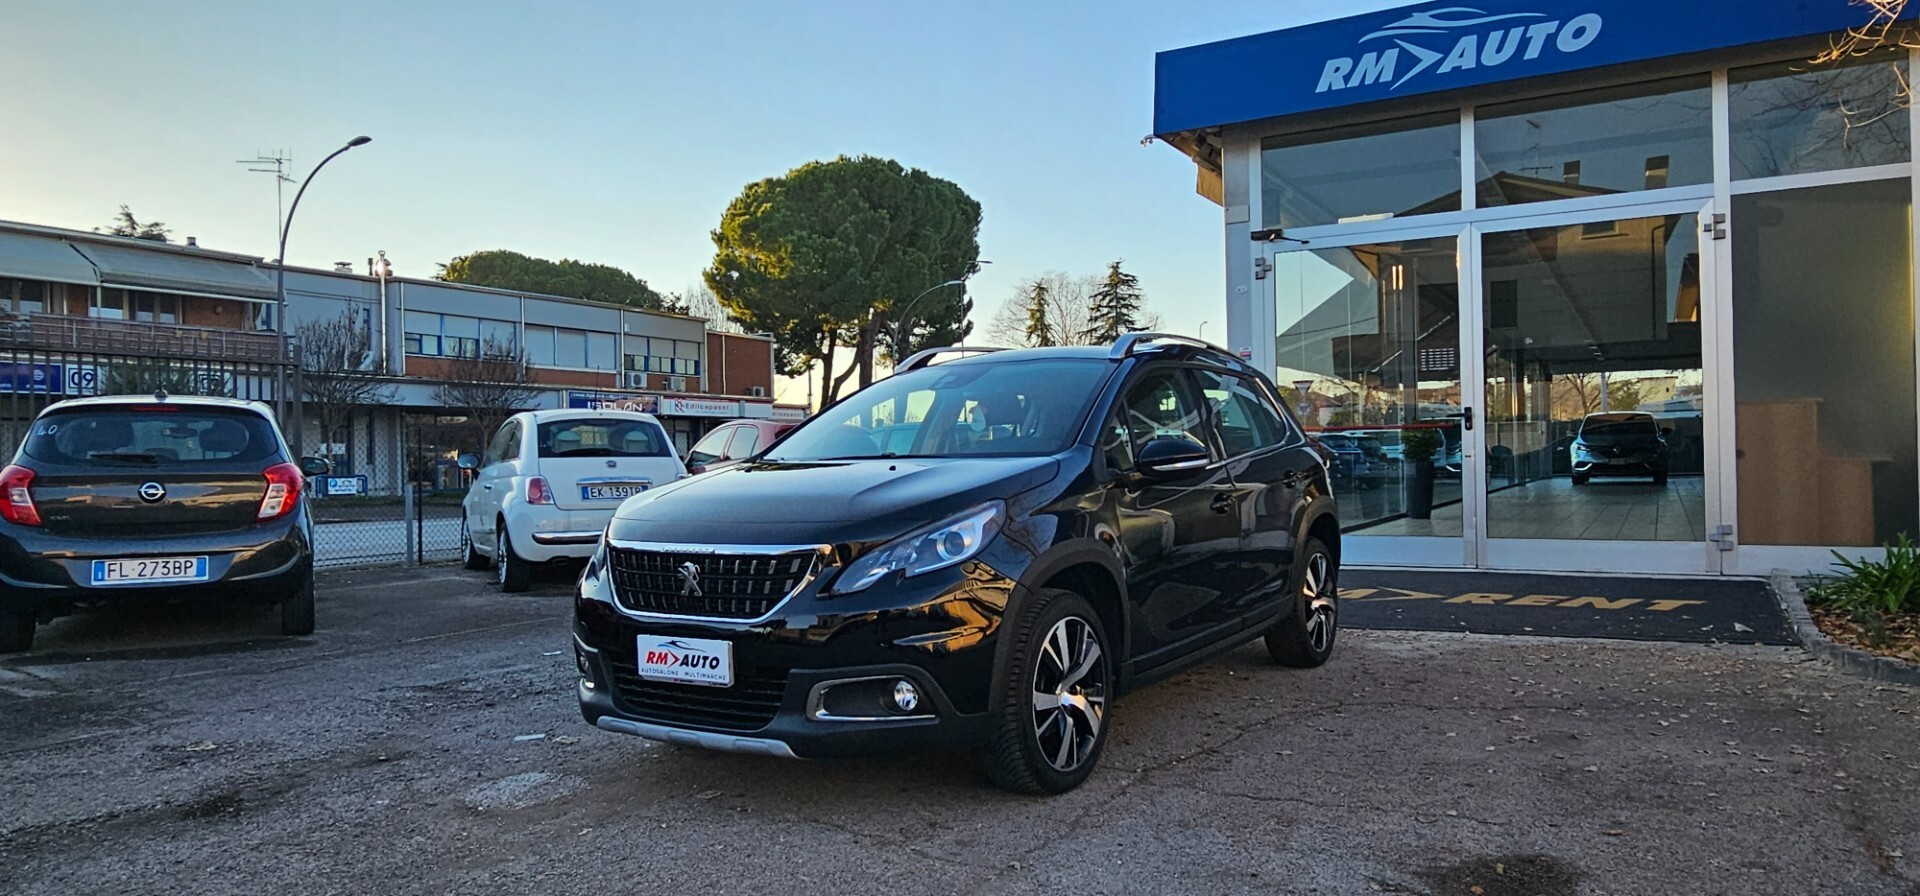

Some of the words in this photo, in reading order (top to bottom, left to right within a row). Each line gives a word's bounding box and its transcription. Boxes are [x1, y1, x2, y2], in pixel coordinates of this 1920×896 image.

[1315, 48, 1400, 93] RM
[1436, 12, 1603, 74] AUTO
[71, 372, 94, 386] 09
[590, 487, 604, 498] EK
[107, 562, 129, 579] FL
[137, 560, 194, 578] 273BP
[1441, 592, 1708, 611] RENT
[646, 651, 669, 666] RM
[679, 654, 720, 670] AUTO
[640, 668, 679, 677] AUTOSALONE
[684, 671, 726, 680] MULTIMARCHE
